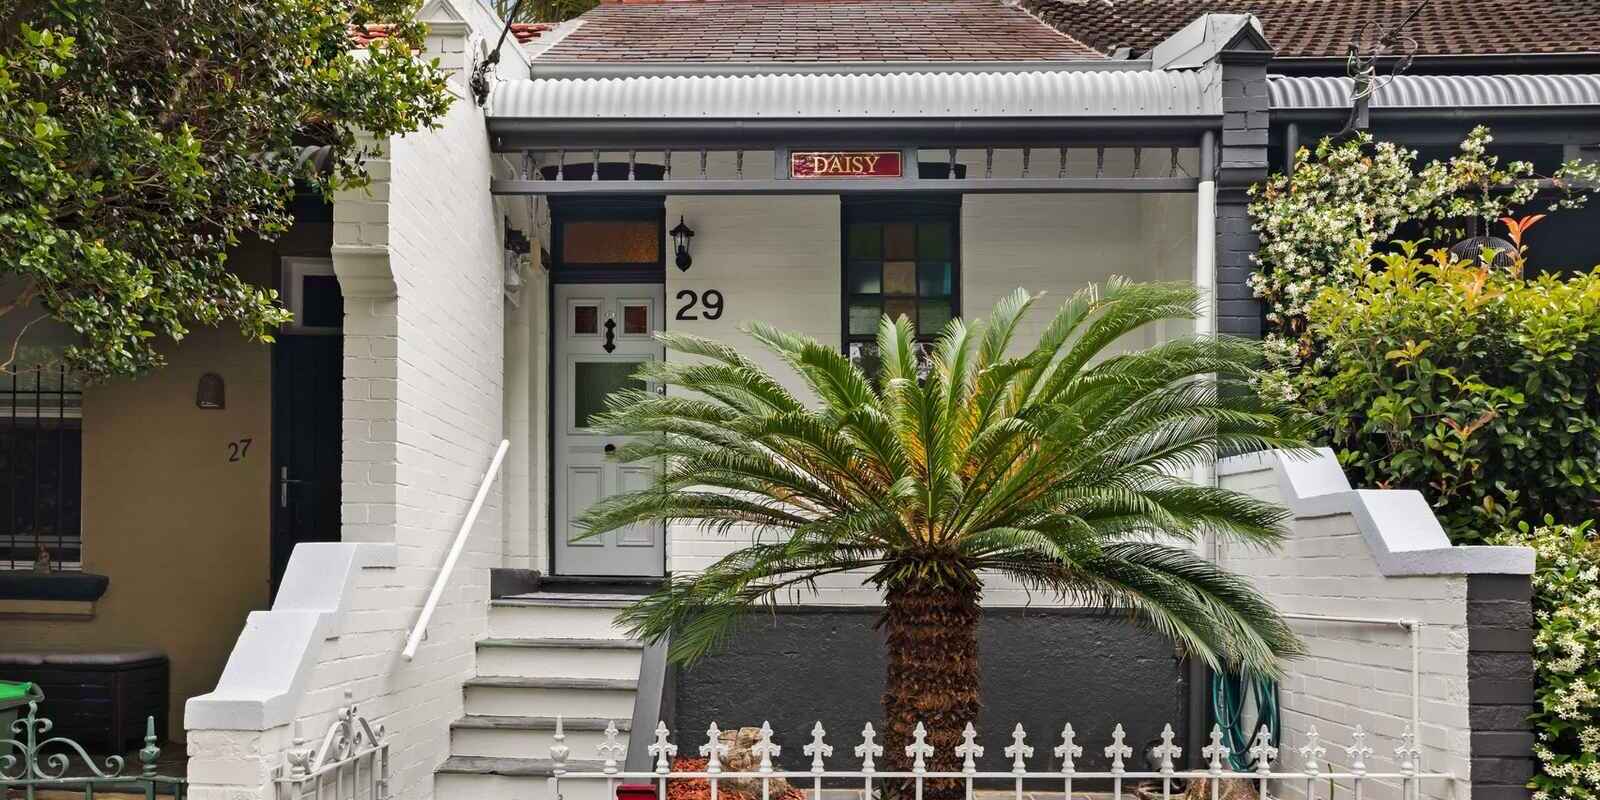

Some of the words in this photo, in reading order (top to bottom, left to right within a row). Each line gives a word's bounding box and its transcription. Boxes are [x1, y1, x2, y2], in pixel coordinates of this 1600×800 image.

[813, 156, 880, 173] DAISY
[676, 289, 723, 320] 29
[228, 438, 252, 462] 27
